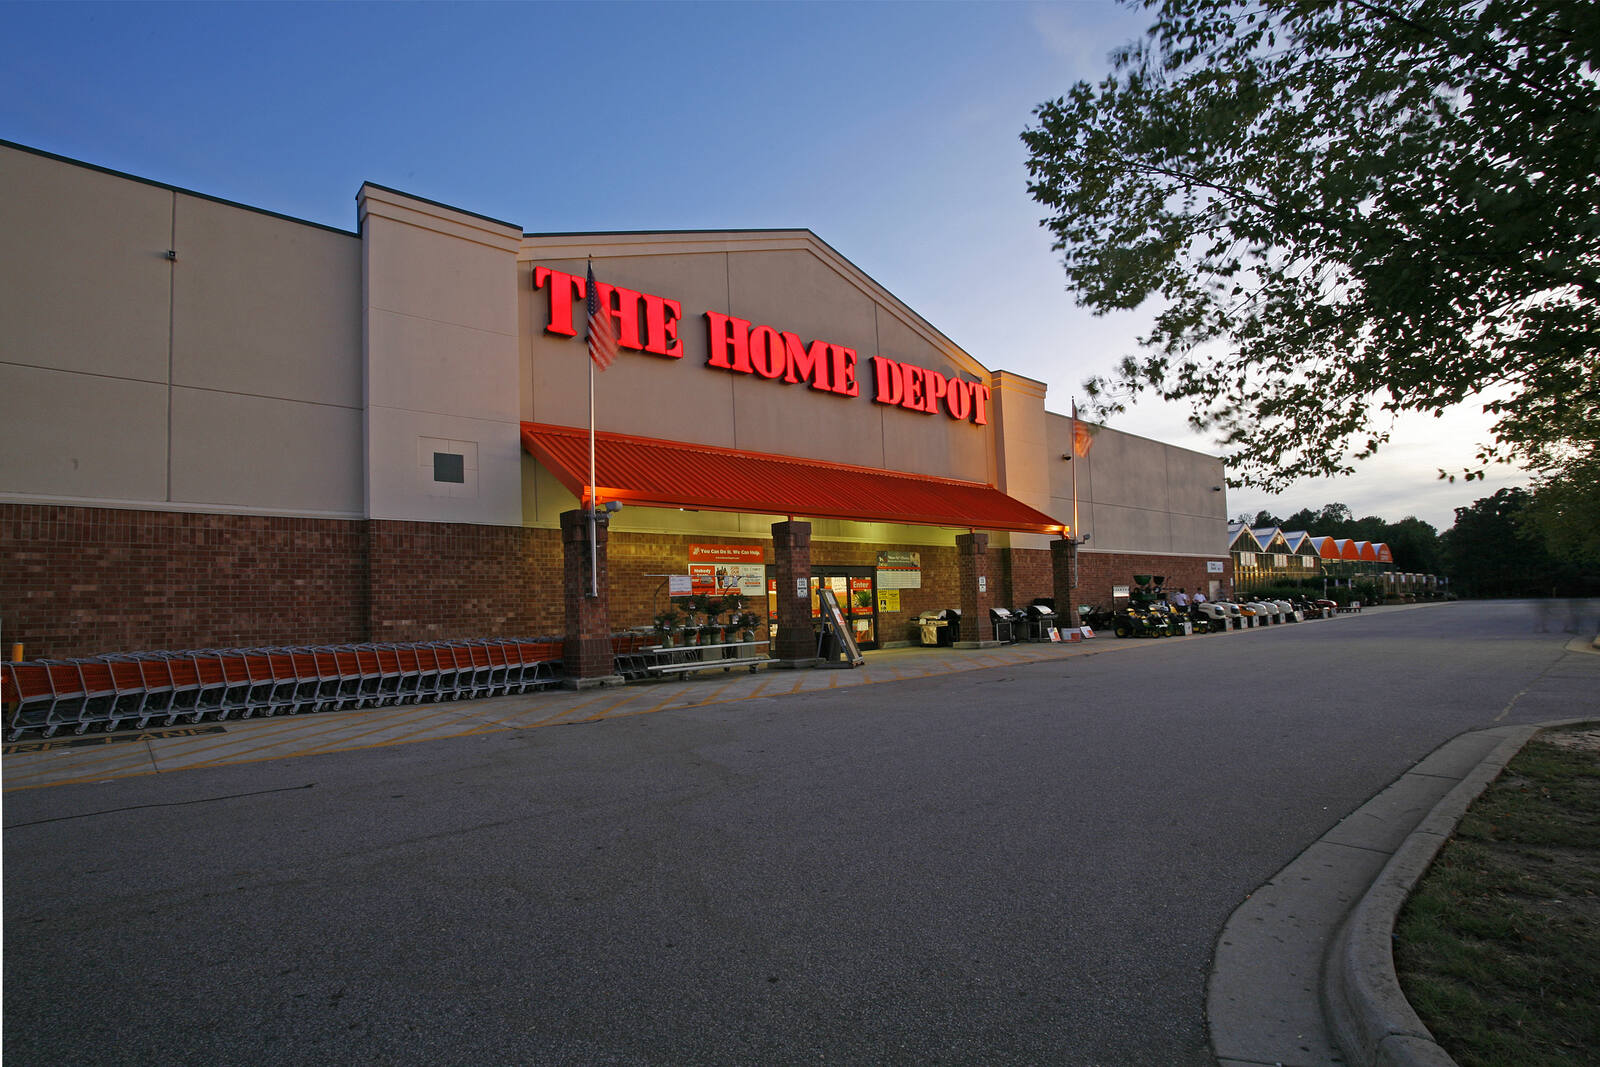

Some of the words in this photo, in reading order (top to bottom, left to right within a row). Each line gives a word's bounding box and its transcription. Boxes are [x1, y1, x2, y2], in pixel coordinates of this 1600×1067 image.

[533, 266, 683, 359] THE
[704, 310, 859, 397] HOME
[870, 355, 990, 425] DEPOT
[853, 580, 869, 589] Enter
[104, 728, 208, 744] LANE
